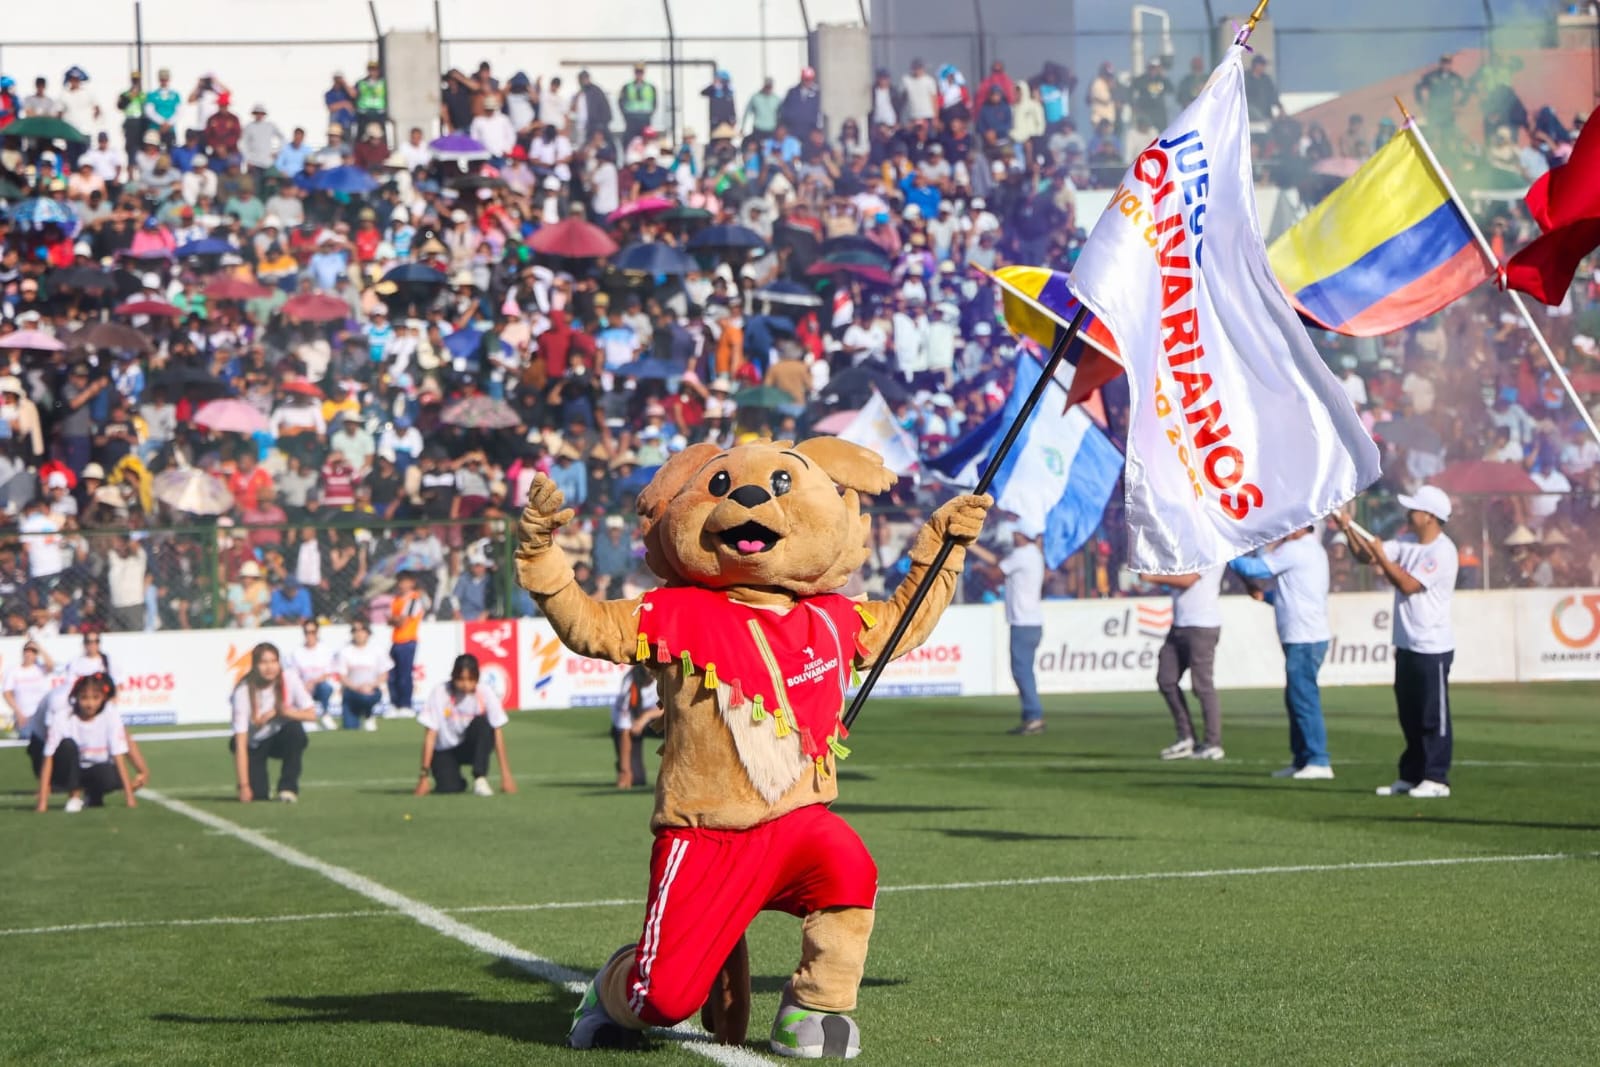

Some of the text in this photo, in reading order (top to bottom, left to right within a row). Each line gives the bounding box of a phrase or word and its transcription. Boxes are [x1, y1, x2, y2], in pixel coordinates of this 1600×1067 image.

[1133, 137, 1264, 521] OLIVARIANOS
[1103, 608, 1131, 637] el
[1373, 610, 1390, 631] e
[903, 645, 962, 662] ANOS
[1039, 642, 1155, 672] almacé
